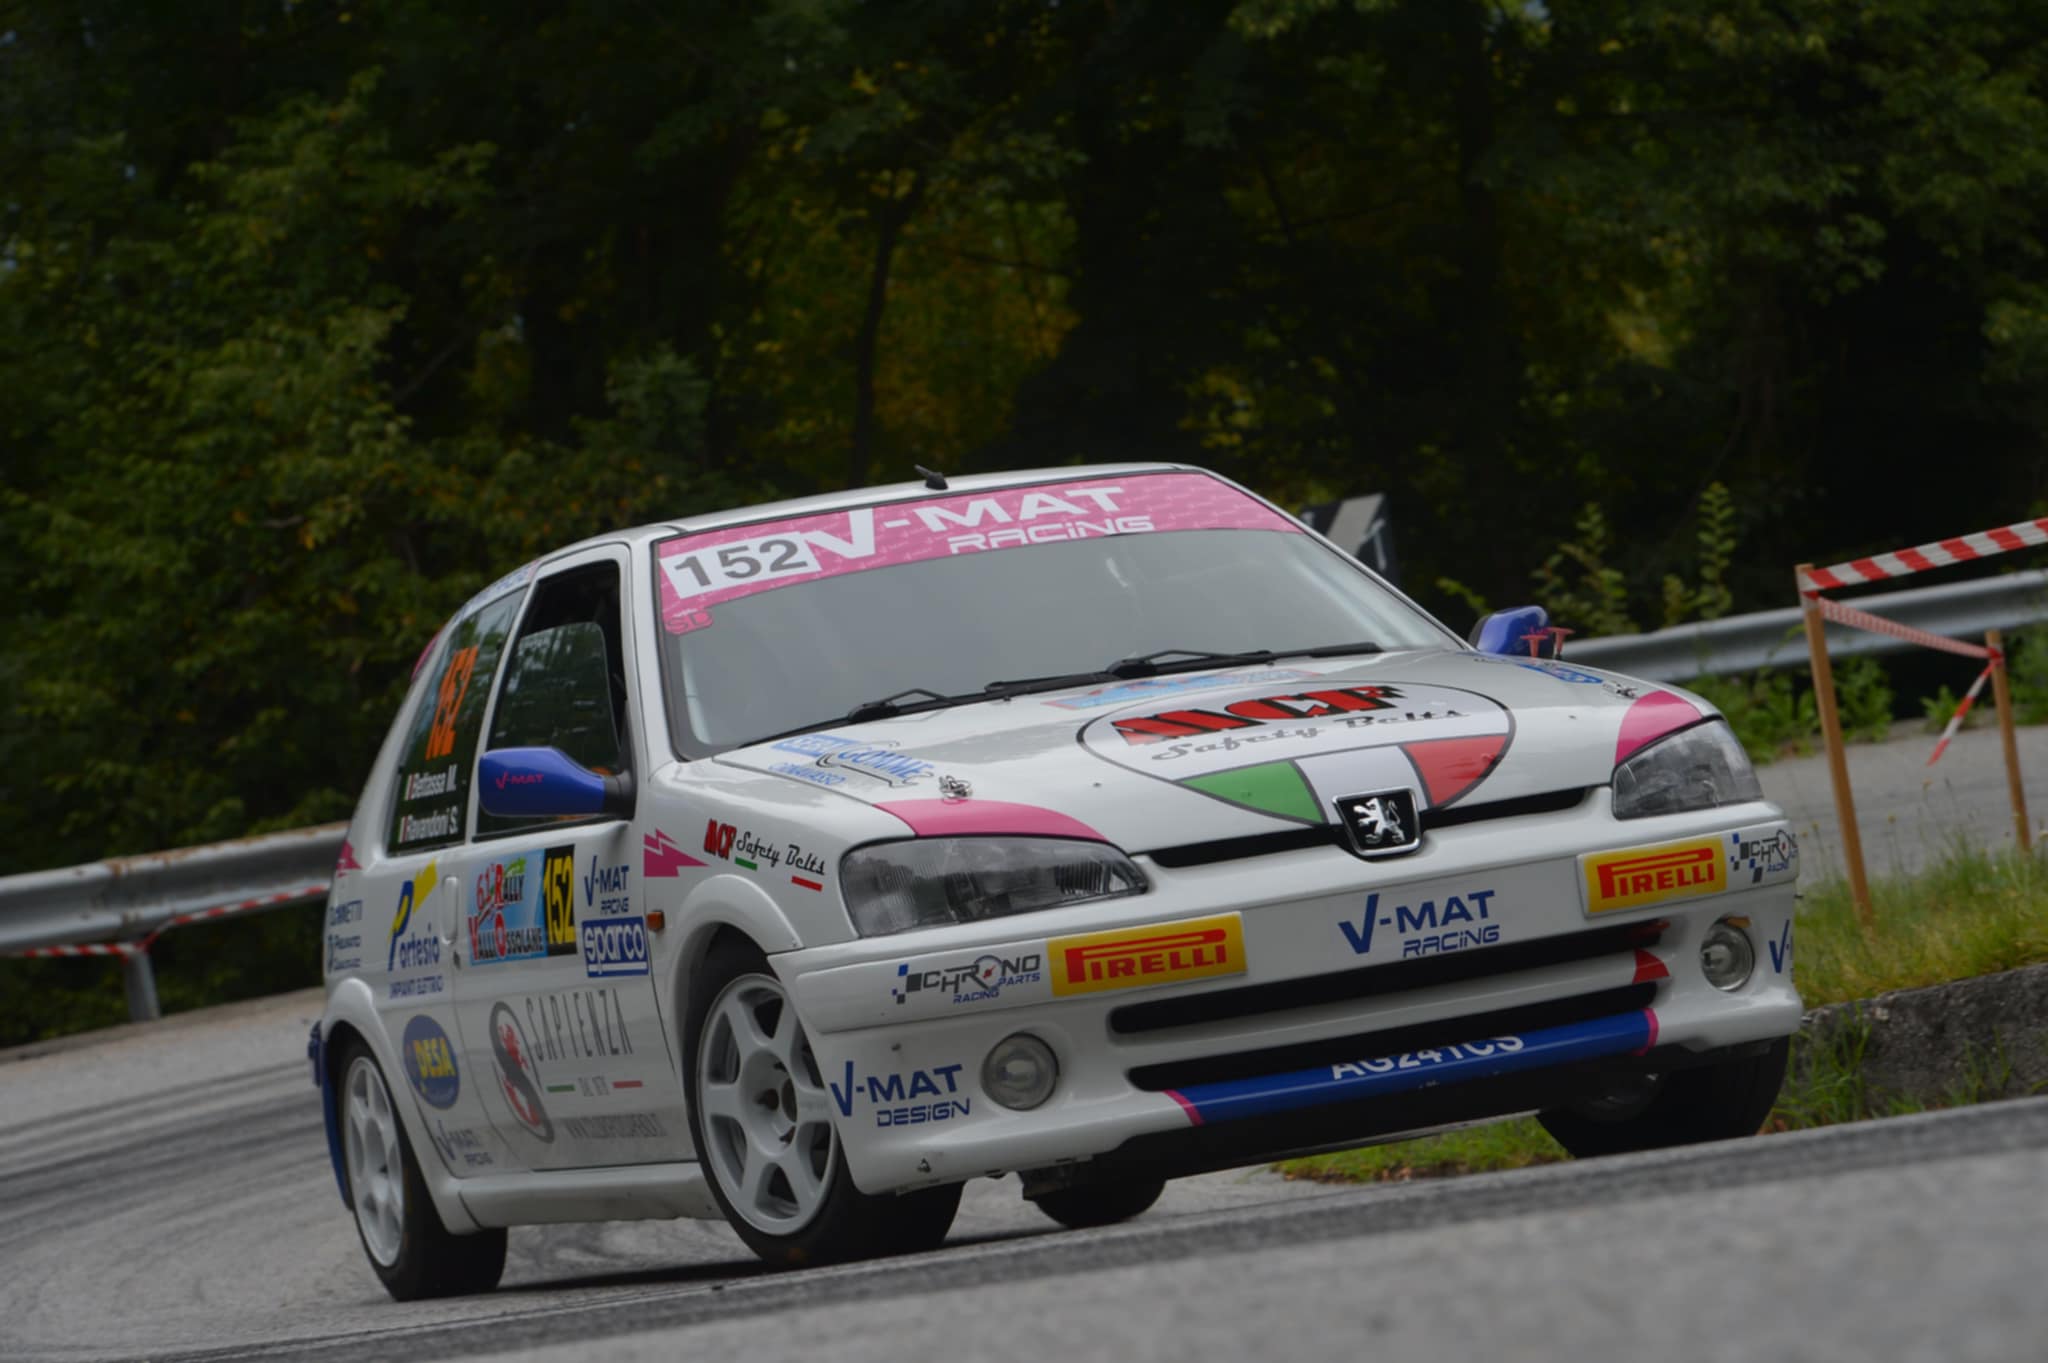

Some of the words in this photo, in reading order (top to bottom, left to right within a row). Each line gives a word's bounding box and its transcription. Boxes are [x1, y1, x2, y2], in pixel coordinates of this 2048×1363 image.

[790, 487, 1125, 559] V-MAT
[674, 538, 809, 588] 152
[1150, 722, 1326, 761] Safety
[1334, 708, 1475, 730] Belts
[736, 831, 780, 868] Safety
[785, 843, 825, 876] Belts
[1597, 847, 1716, 899] PIRELLI
[543, 855, 576, 945] 152
[584, 855, 630, 908] V-MAT
[1338, 889, 1496, 955] V-MAT
[584, 924, 645, 975] sparco
[922, 954, 1042, 993] CHRONO
[1065, 929, 1227, 985] PIRELLI
[953, 990, 1000, 1004] RACING
[998, 972, 1041, 988] PARTS
[525, 988, 634, 1062] SAPIENZA
[830, 1060, 963, 1118] V-MAT
